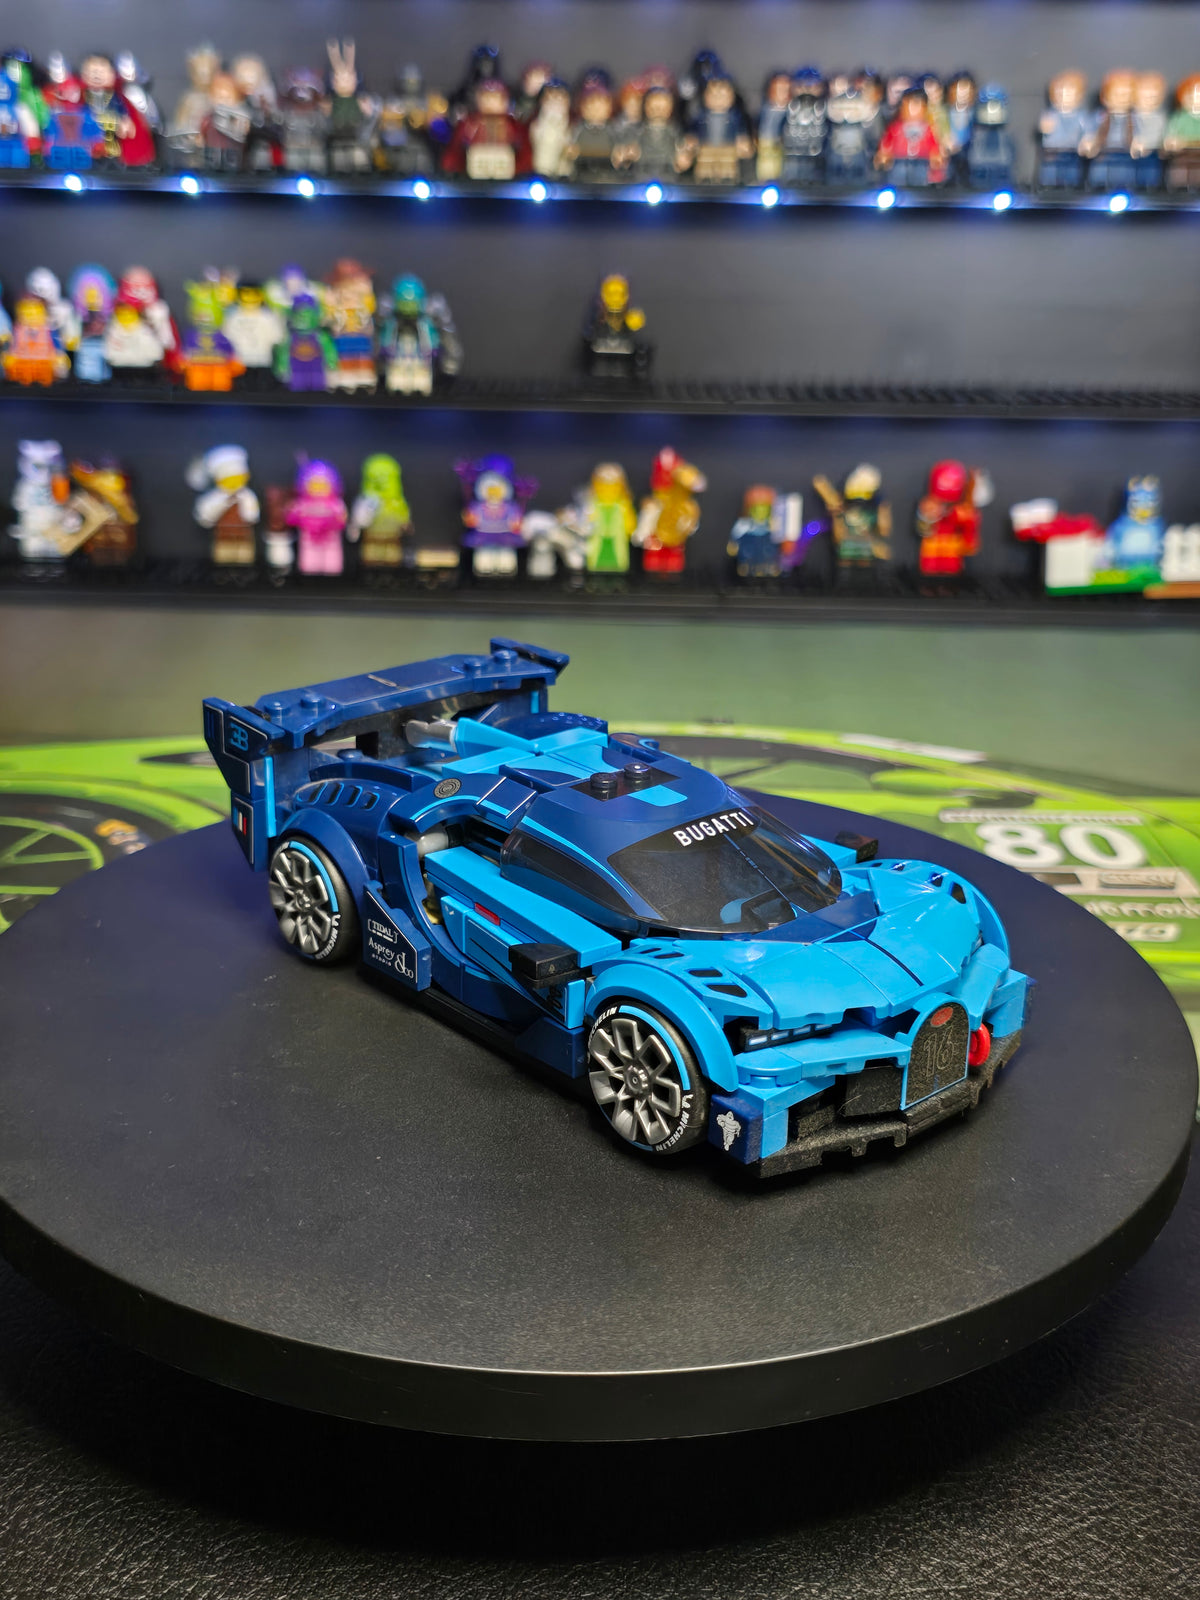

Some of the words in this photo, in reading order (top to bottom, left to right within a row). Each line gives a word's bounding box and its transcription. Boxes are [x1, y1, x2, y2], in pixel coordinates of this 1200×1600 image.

[673, 811, 754, 847] BUGATTI
[976, 823, 1147, 870] 80
[371, 920, 394, 938] TIDAL
[368, 937, 395, 960] Asprey
[656, 1112, 690, 1152] MICHELIN
